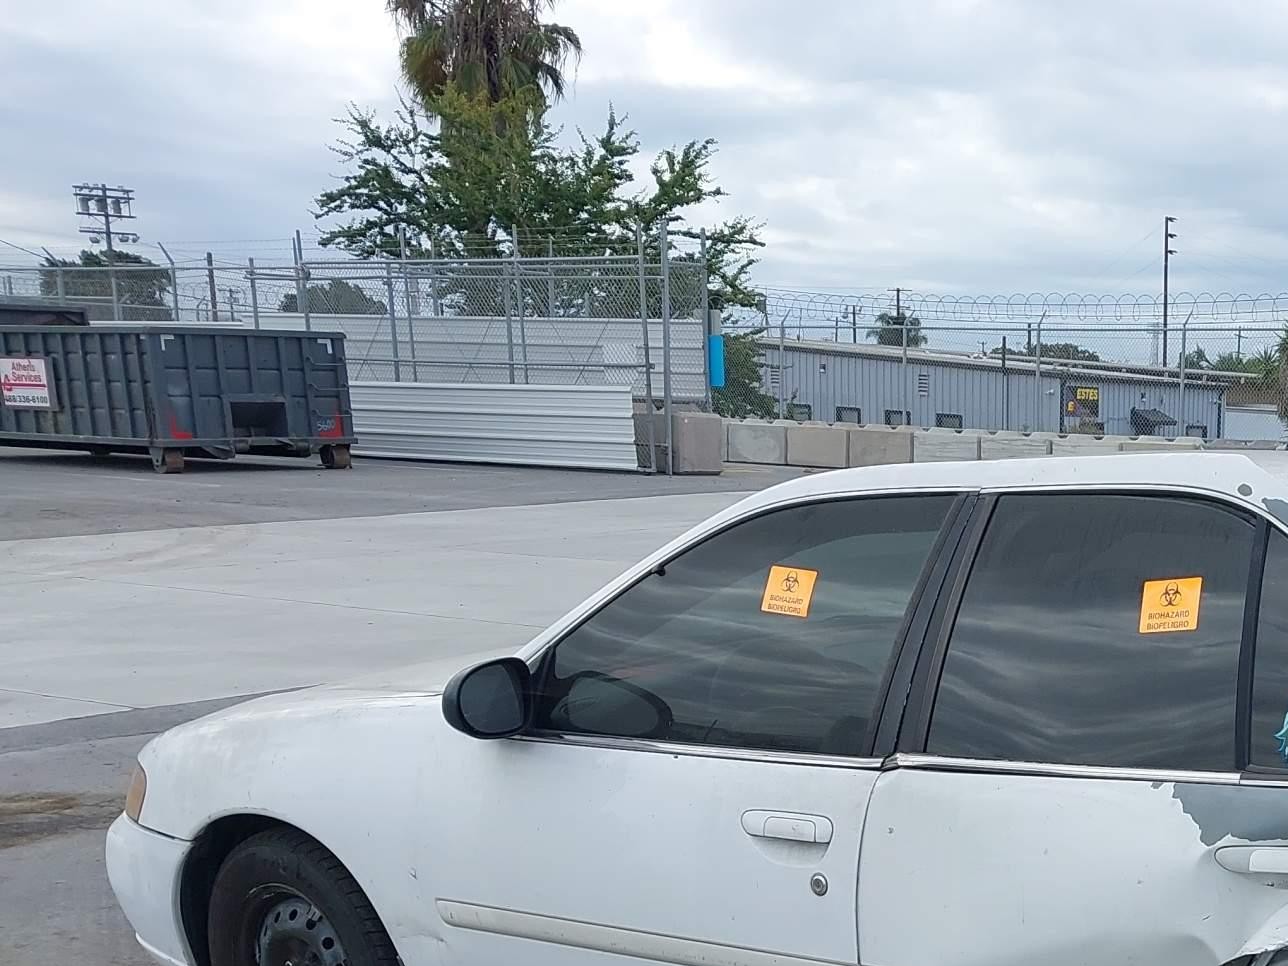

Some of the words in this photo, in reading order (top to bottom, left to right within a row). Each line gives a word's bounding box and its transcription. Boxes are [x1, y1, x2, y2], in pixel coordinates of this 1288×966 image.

[11, 371, 42, 382] Services
[1076, 388, 1098, 400] ESTES
[769, 594, 804, 605] BIOHAZARD
[1148, 609, 1190, 620] BIOHAZARD
[1146, 620, 1189, 631] BIOPELIGRO
